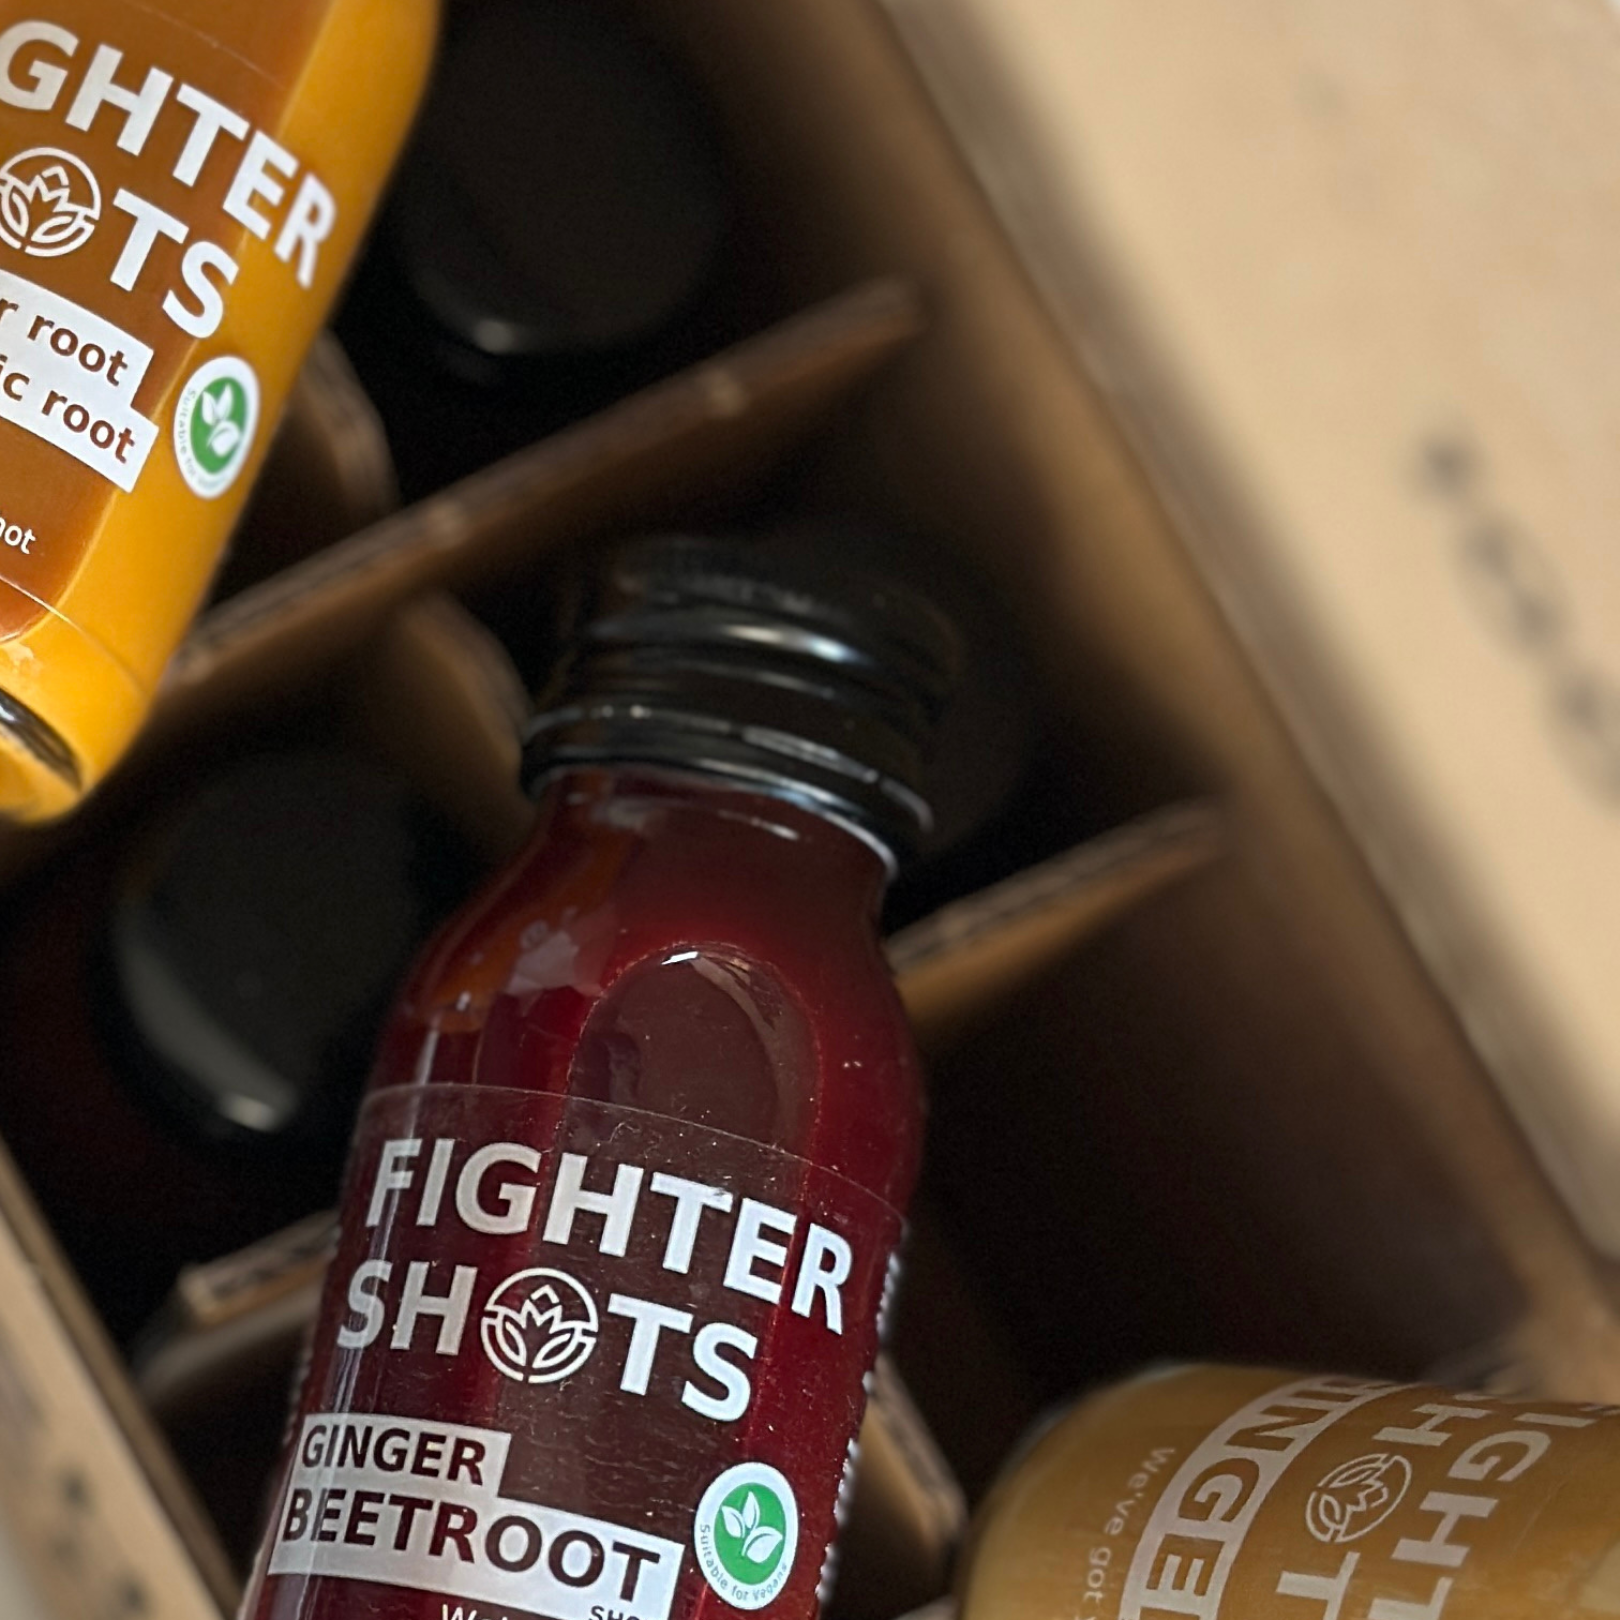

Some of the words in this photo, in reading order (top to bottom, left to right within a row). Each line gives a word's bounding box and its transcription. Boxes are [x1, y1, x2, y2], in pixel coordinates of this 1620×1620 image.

[27, 313, 128, 387] root
[41, 390, 136, 464] root
[365, 1137, 854, 1335] FIGHTER
[301, 1425, 487, 1486] GINGER
[1104, 1447, 1176, 1536] We've
[282, 1488, 661, 1604] BEETROOT
[700, 1524, 729, 1590] Suitable
[731, 1585, 749, 1601] for
[1083, 1547, 1111, 1603] got
